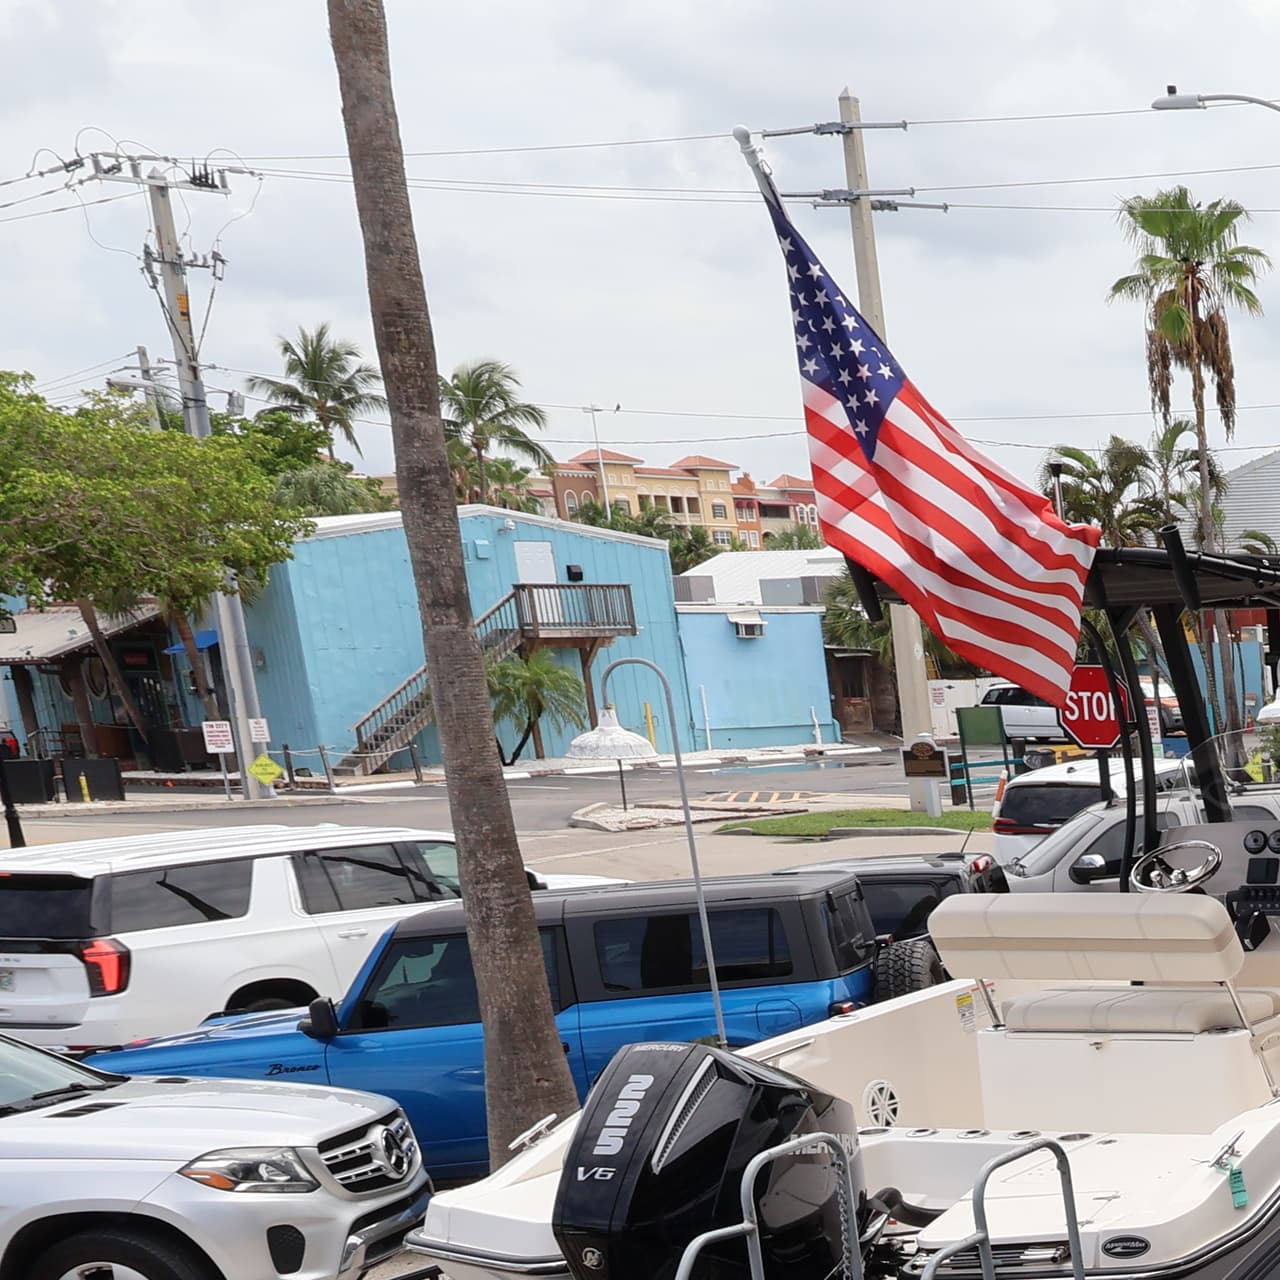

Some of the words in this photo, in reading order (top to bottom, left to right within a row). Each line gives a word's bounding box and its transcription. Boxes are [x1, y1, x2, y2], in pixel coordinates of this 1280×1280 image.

[264, 1063, 321, 1076] Bronco
[593, 1074, 655, 1156] 225
[577, 1166, 616, 1181] V6
